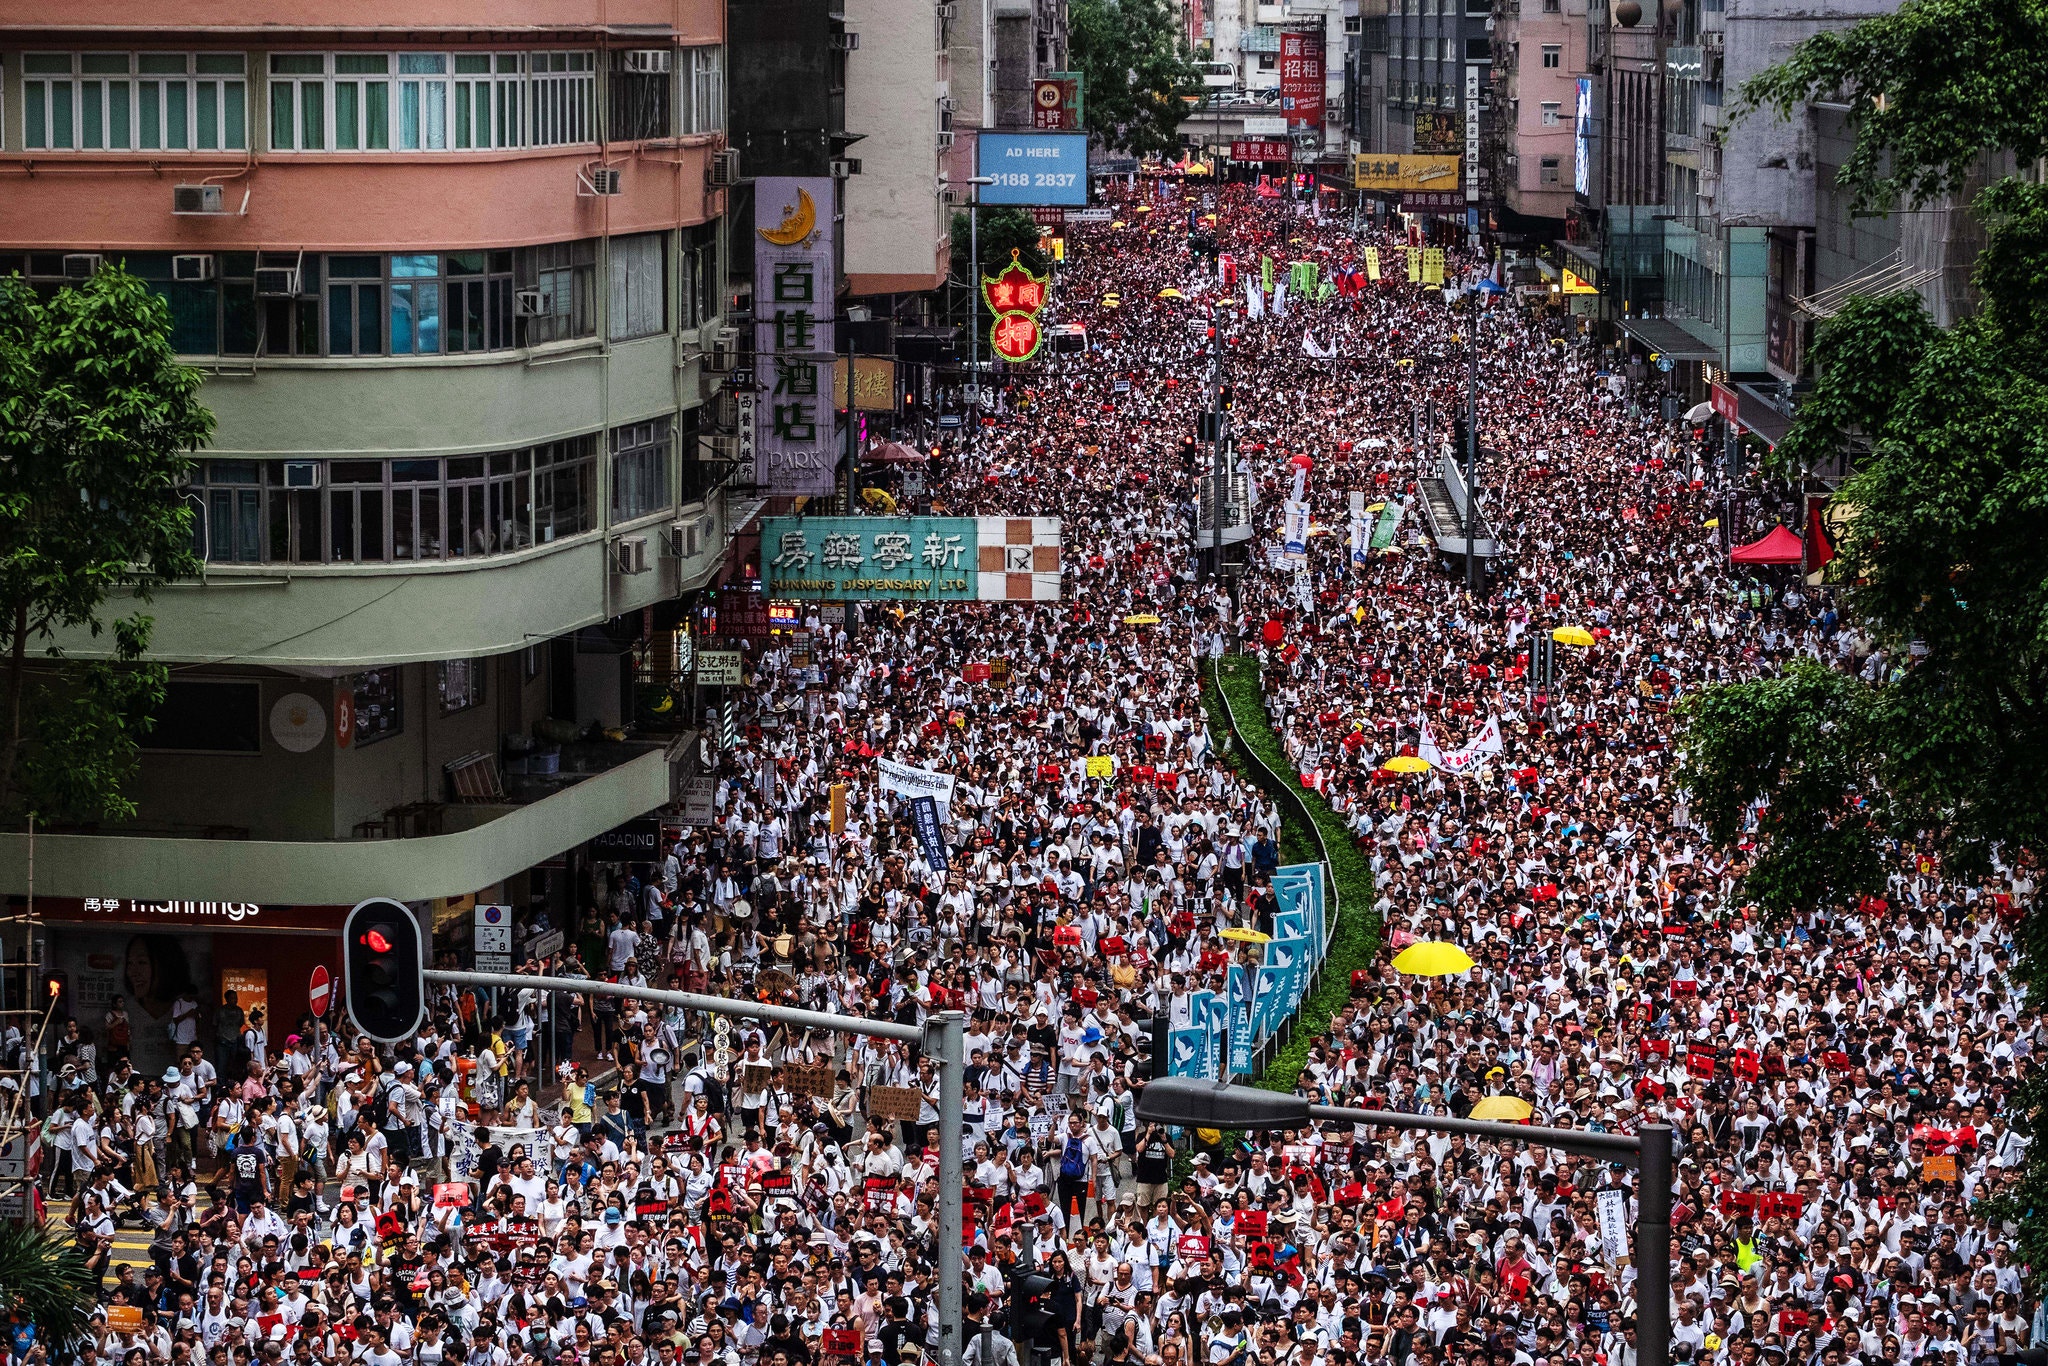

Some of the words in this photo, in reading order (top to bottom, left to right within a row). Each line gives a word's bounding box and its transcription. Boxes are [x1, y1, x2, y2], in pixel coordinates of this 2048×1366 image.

[1285, 39, 1319, 56] 廣告
[1285, 60, 1319, 78] 招租
[1006, 148, 1022, 158] AD
[1026, 148, 1060, 158] HERE
[989, 173, 1029, 187] 3188
[1035, 173, 1076, 187] 2837
[1403, 193, 1464, 206] 潮興魚蛋粉
[1567, 274, 1573, 282] P
[997, 316, 1032, 353] 押
[774, 262, 817, 441] 百佳酒店
[769, 451, 822, 470] PARK
[769, 578, 836, 592] SUNNING
[841, 578, 932, 592] DISPENSARY
[722, 595, 764, 610] 許氏
[747, 625, 767, 635] 1968
[498, 929, 505, 938] 7
[499, 943, 506, 951] 8
[1232, 1007, 1250, 1068] 民主黨
[10, 1163, 17, 1173] 7
[466, 1222, 499, 1236] 反送中
[507, 1221, 539, 1236] 反送中
[514, 1265, 547, 1279] 反送中
